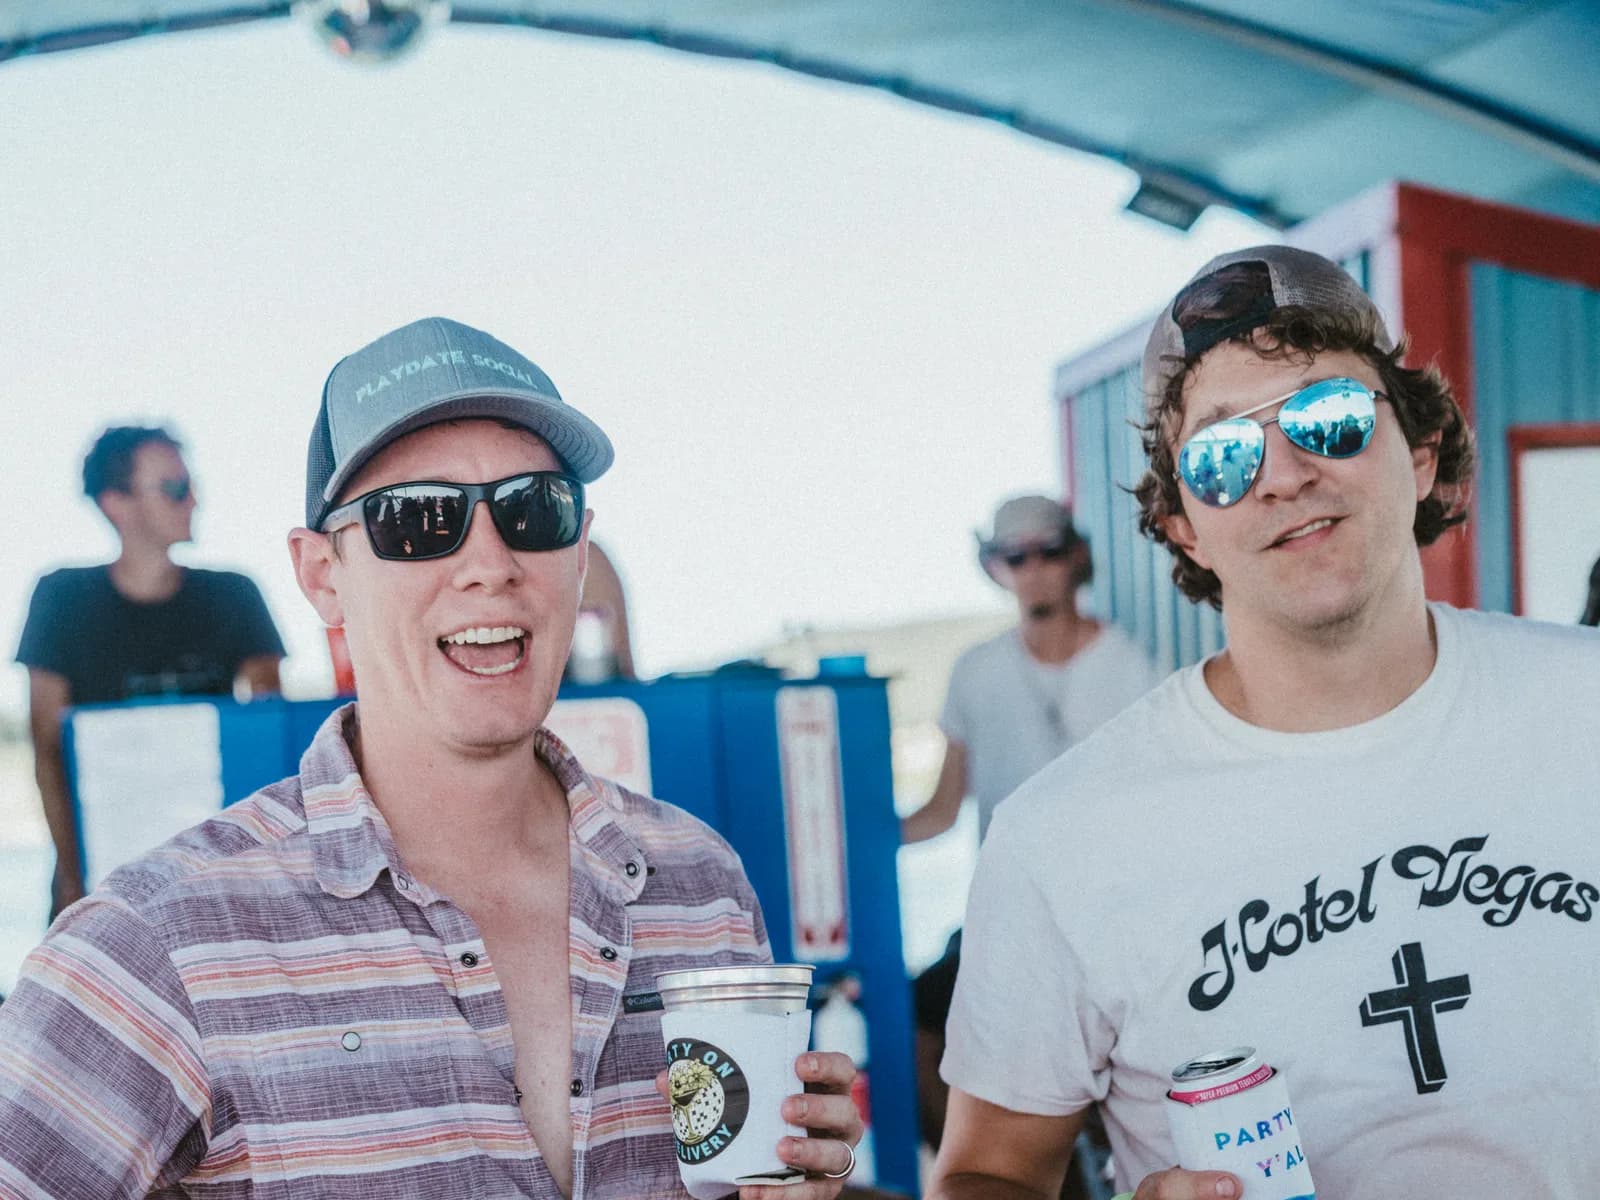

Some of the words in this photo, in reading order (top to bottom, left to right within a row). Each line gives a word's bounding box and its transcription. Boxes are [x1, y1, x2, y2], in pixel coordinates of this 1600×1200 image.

[355, 350, 465, 404] PLAYDATE
[471, 353, 539, 390] SOCIAL
[1188, 854, 1385, 1011] Hotel
[1391, 833, 1599, 927] Vegas
[703, 1051, 734, 1078] ON
[1214, 1106, 1292, 1150] PARTY
